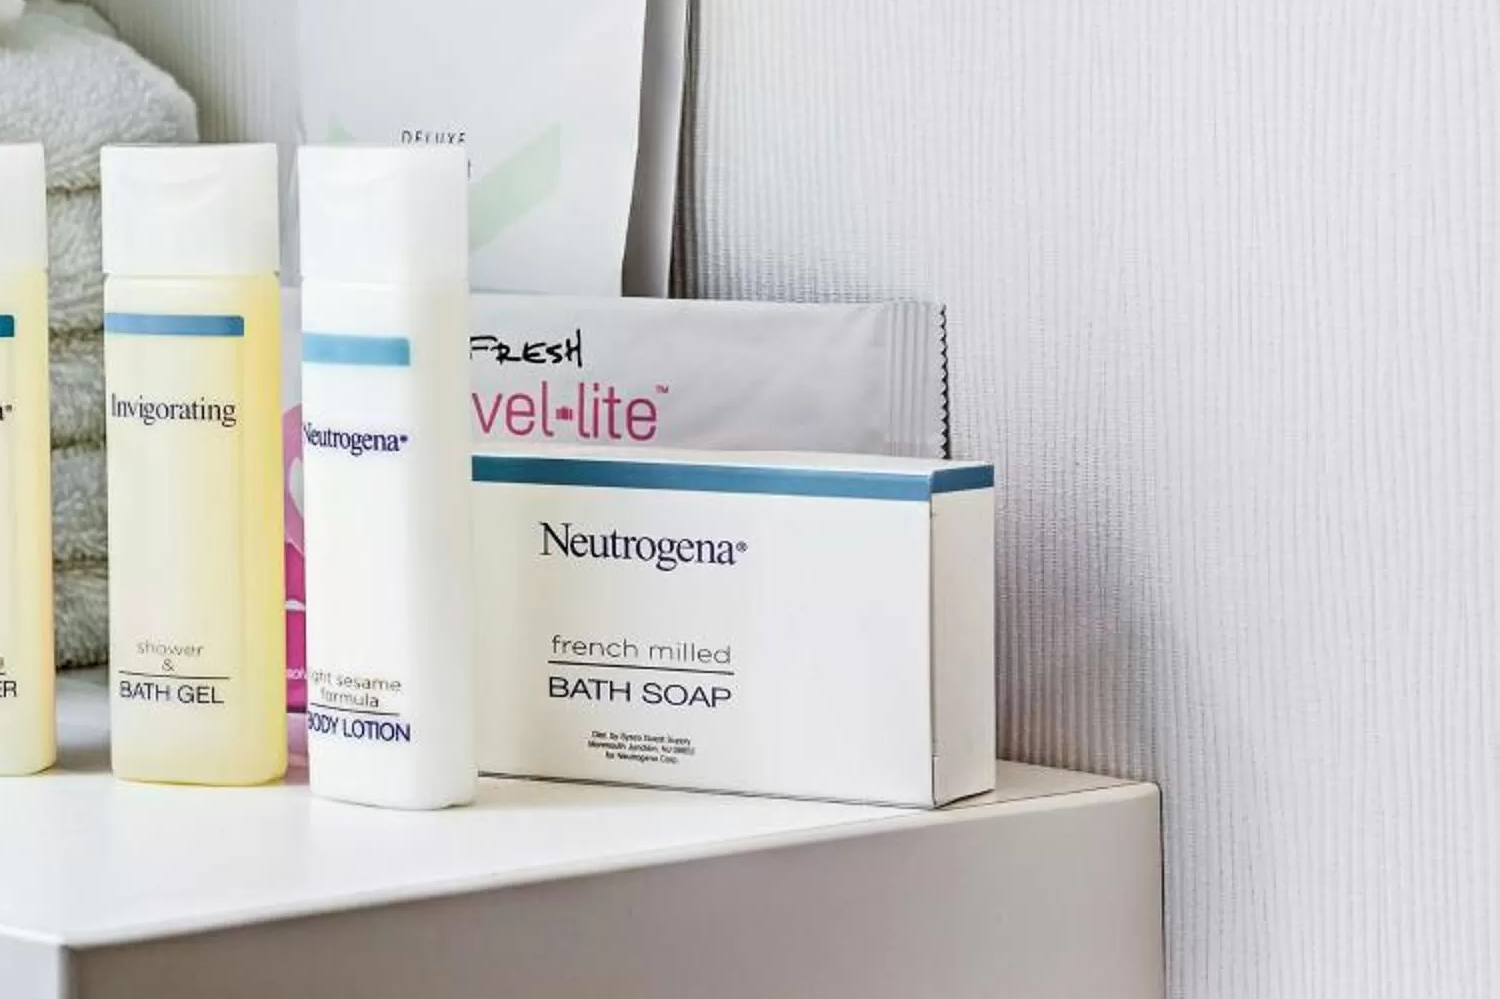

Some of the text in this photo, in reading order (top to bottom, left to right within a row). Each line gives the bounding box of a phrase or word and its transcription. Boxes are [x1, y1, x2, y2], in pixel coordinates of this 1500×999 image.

[469, 328, 583, 368] FRESH
[111, 392, 237, 428] Invigorating
[136, 640, 205, 657] shower
[551, 634, 731, 664] french milled
[161, 657, 175, 672] &
[119, 680, 225, 704] BATH GEL
[336, 673, 402, 692] sesame
[548, 676, 732, 708] BATH SOAP
[320, 686, 380, 708] formula
[343, 718, 411, 742] LOTION
